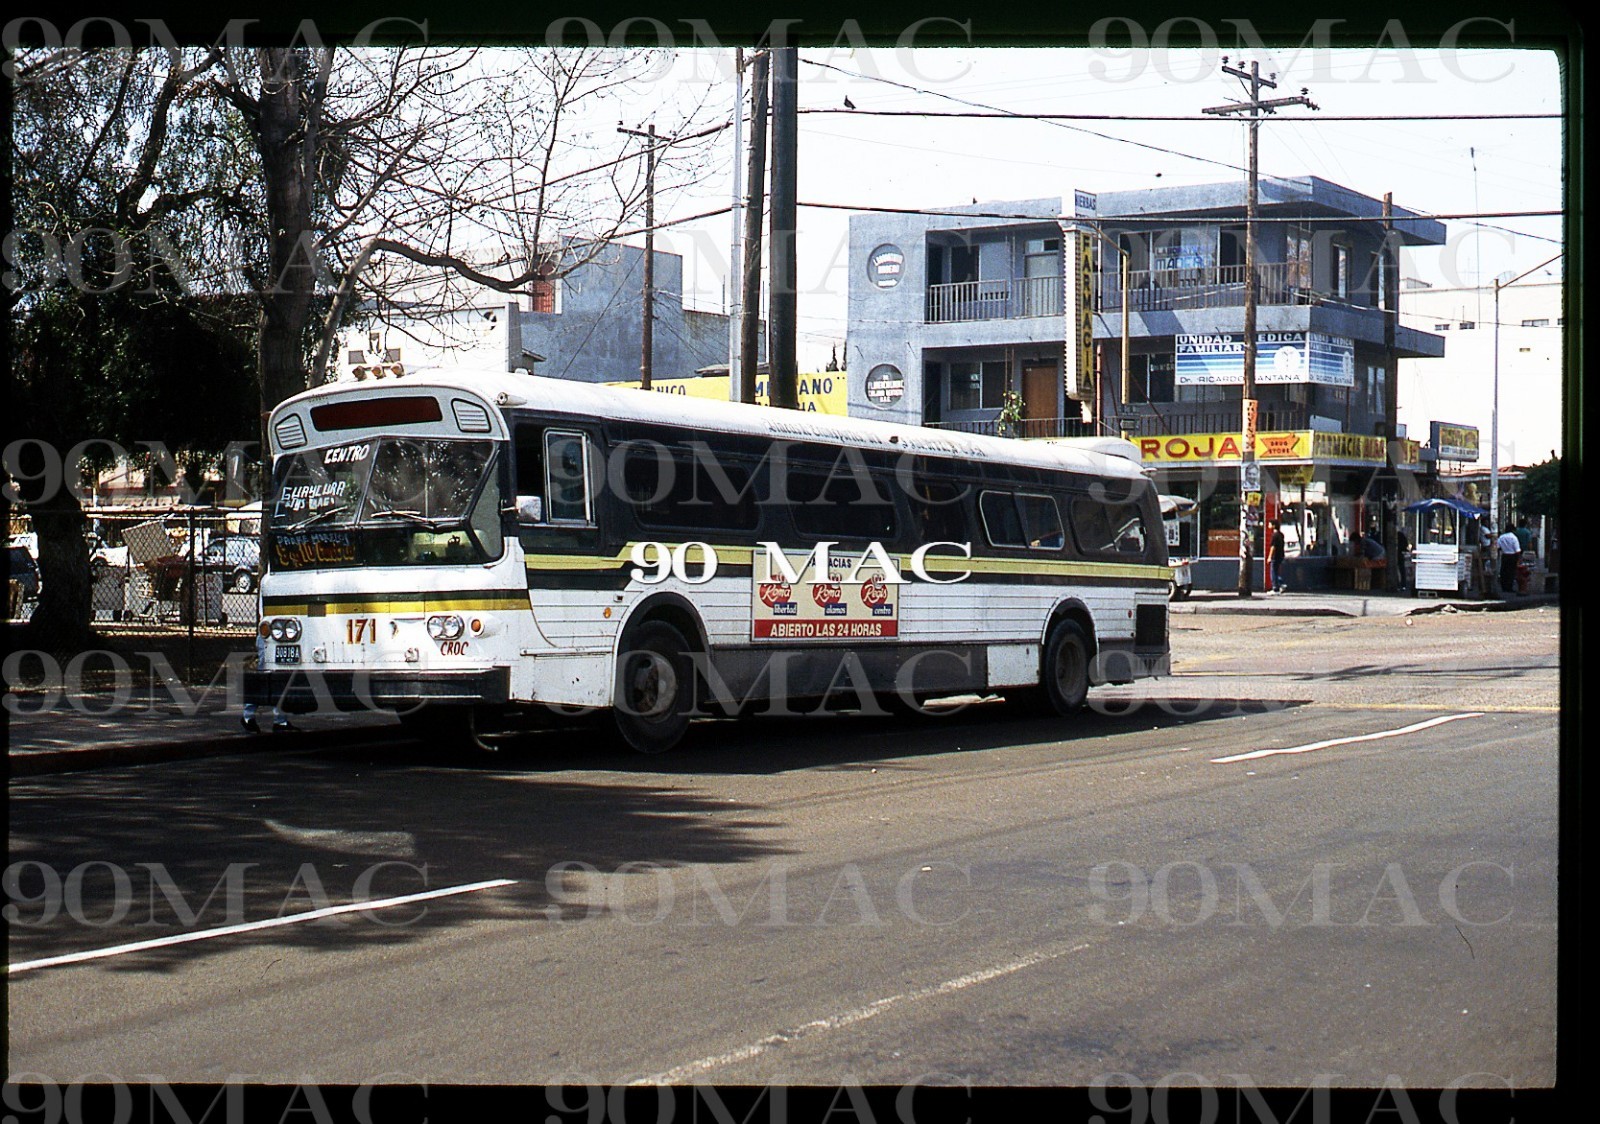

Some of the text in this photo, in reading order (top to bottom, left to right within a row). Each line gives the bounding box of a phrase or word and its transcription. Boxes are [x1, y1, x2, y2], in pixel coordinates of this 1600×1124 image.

[1083, 235, 1093, 390] FARMACIA
[1179, 333, 1300, 344] UNIDAD EDICA
[1178, 344, 1243, 353] FAMILIAR
[1257, 374, 1300, 382] ANTANA
[324, 444, 369, 464] CENTRO
[1141, 436, 1242, 460] ROJA
[808, 557, 852, 568] FAACIAS
[762, 584, 791, 601] Roma
[814, 584, 841, 601] Roma
[774, 604, 797, 614] libertad
[874, 606, 892, 615] centro
[346, 618, 376, 644] 171
[770, 624, 882, 637] ABIERTO LAS 24 HORAS
[440, 641, 469, 656] CROC
